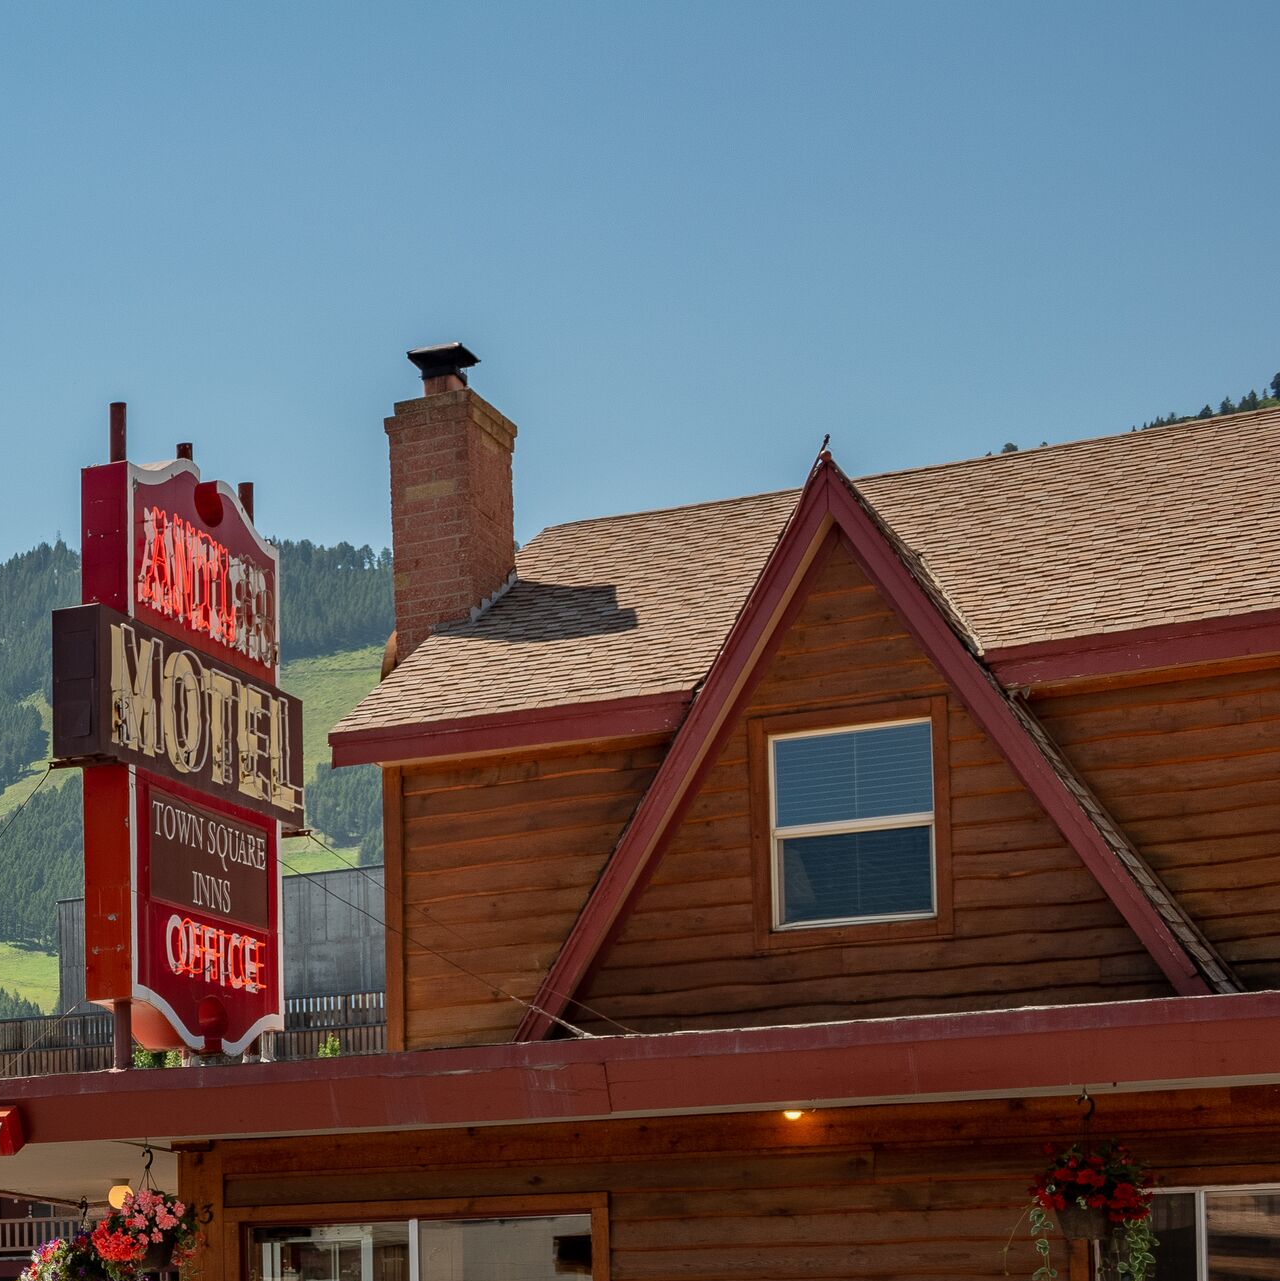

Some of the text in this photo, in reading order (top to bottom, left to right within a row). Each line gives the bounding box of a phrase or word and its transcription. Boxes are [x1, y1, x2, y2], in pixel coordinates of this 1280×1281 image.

[110, 623, 303, 811] MOTEL
[152, 800, 266, 872] TOWN SQUARE
[192, 871, 231, 914] INNS
[166, 914, 267, 994] OFFICE
